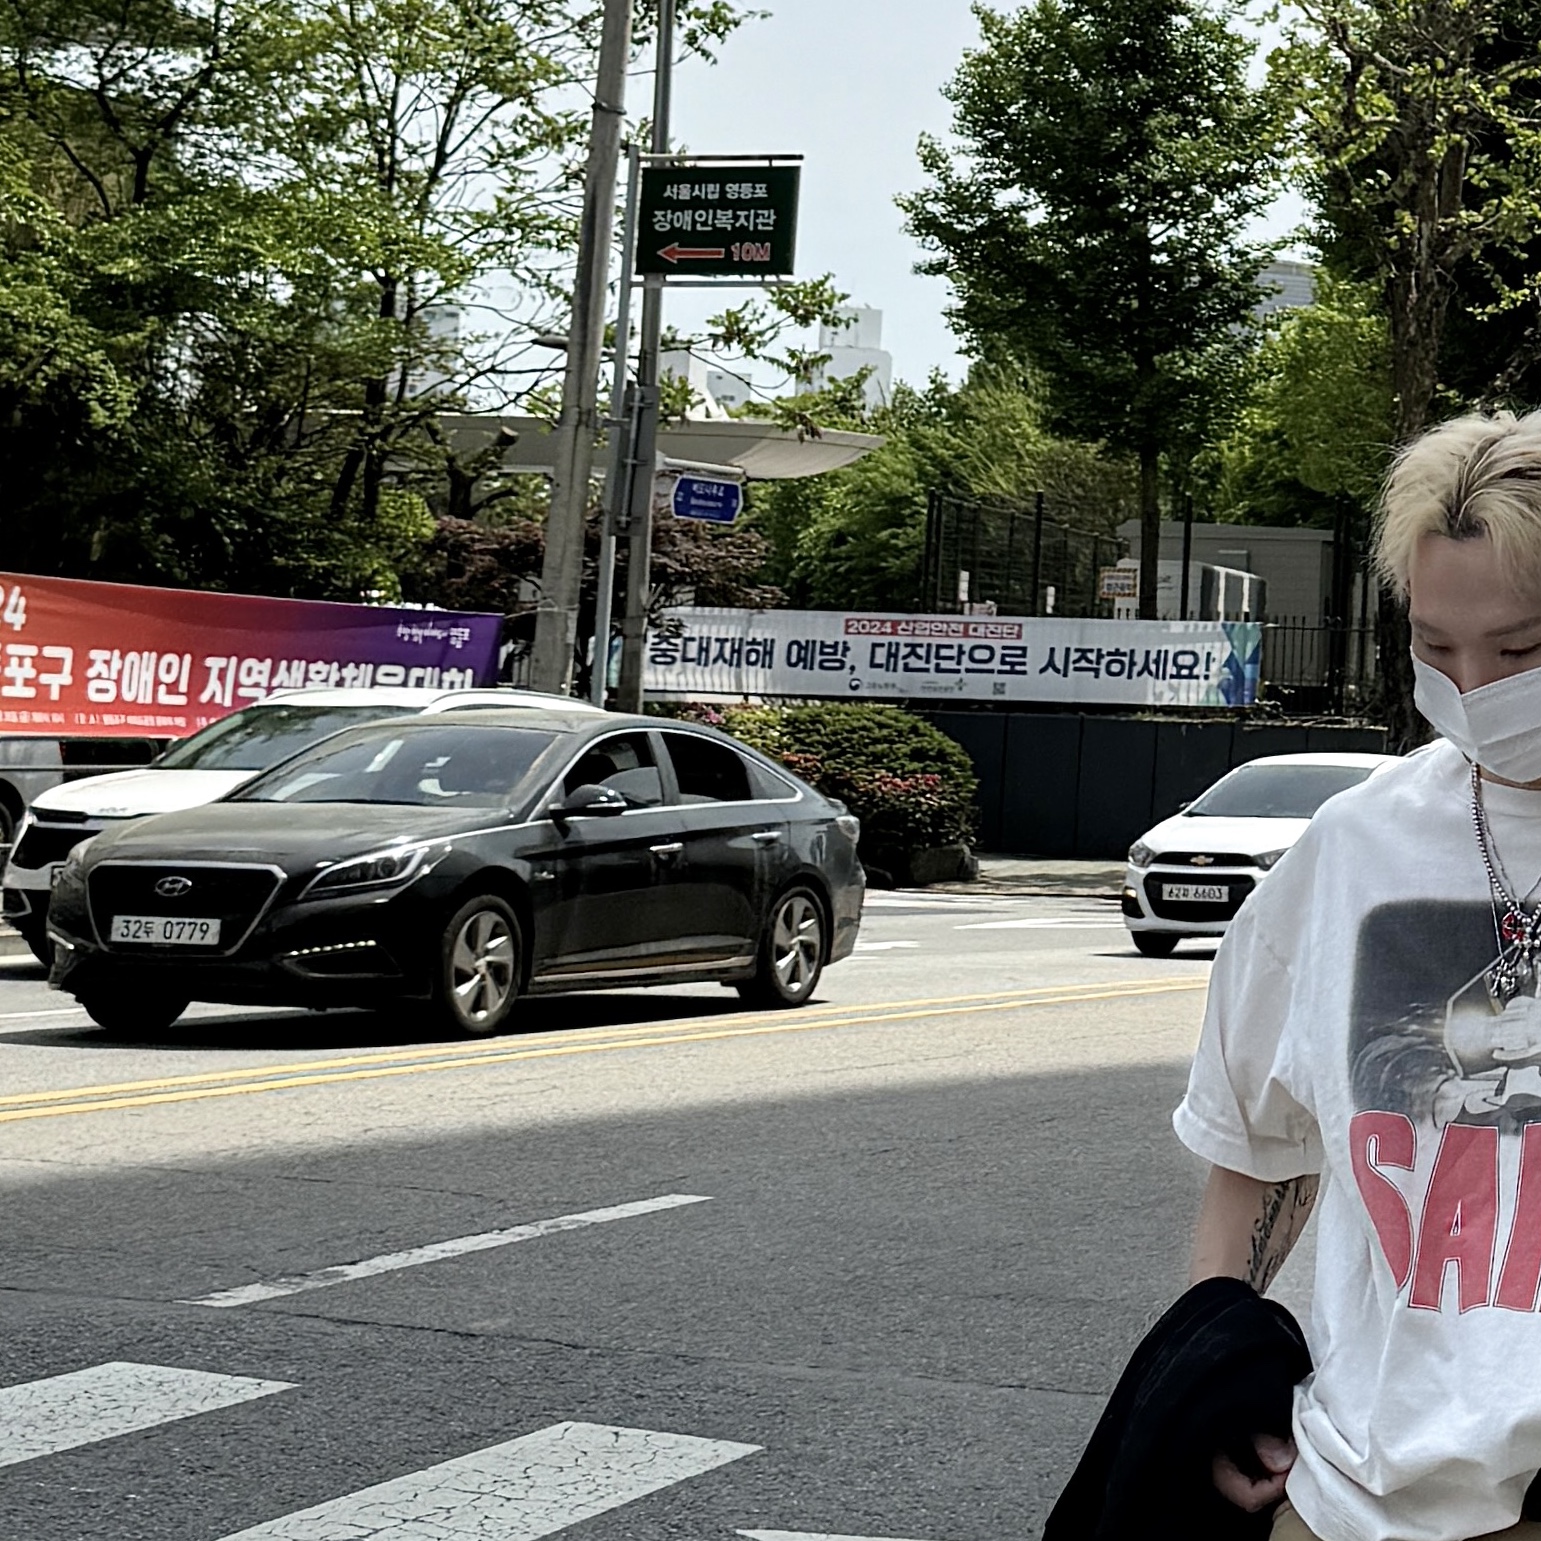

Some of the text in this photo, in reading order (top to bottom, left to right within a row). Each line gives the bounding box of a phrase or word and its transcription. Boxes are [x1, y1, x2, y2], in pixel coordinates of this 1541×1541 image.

[663, 183, 768, 200] 서울시립 영등포
[652, 208, 777, 231] 장애인복지관
[730, 242, 771, 261] 10M
[0, 585, 27, 631] 4
[847, 620, 1019, 639] 2024 산업안전 대진단
[649, 633, 1213, 681] 중대재해 예방, 대진단으로 시작하세요!
[0, 643, 74, 701] 포구
[86, 648, 192, 705] 장애인
[120, 919, 210, 940] 32두 0779
